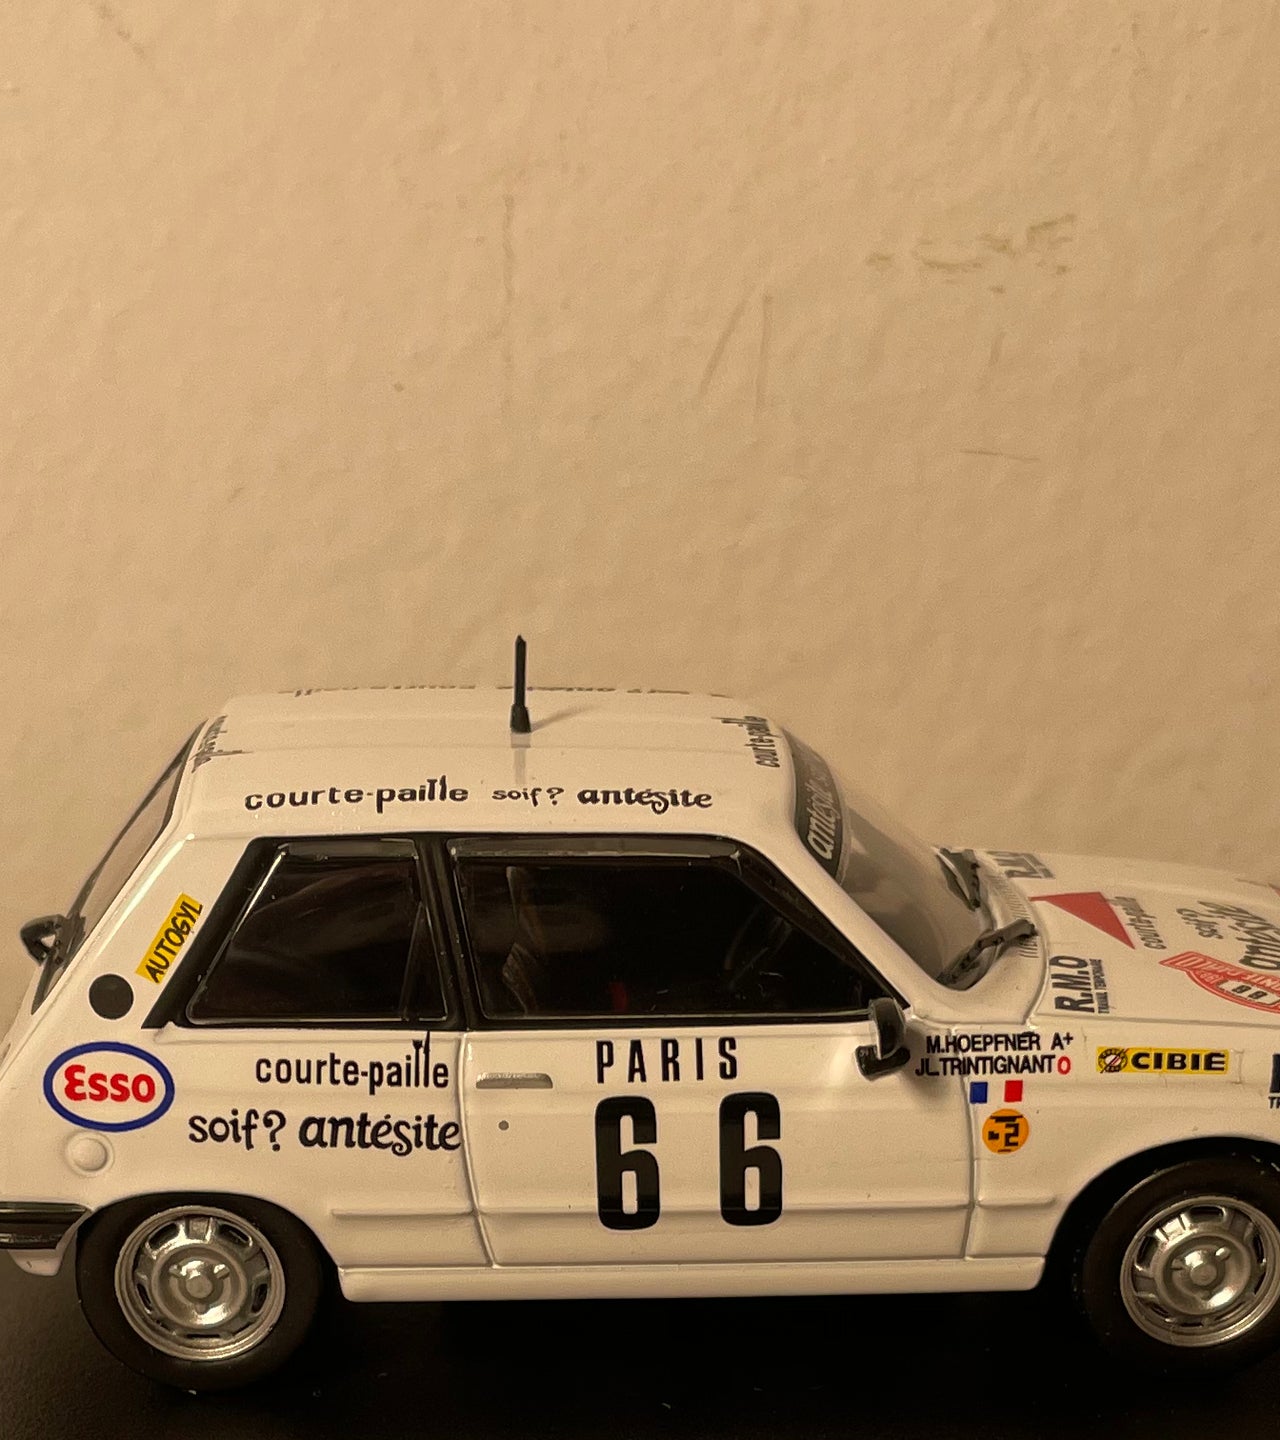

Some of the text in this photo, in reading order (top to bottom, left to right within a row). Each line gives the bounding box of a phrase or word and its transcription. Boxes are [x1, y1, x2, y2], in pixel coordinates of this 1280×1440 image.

[244, 775, 713, 814] courte-paille soif? antésite
[145, 901, 203, 983] AUTOGYL
[1049, 956, 1094, 1012] R.M.O
[256, 1031, 449, 1095] courte-paille
[596, 1037, 738, 1084] PARIS
[189, 1109, 461, 1156] soif? antésite
